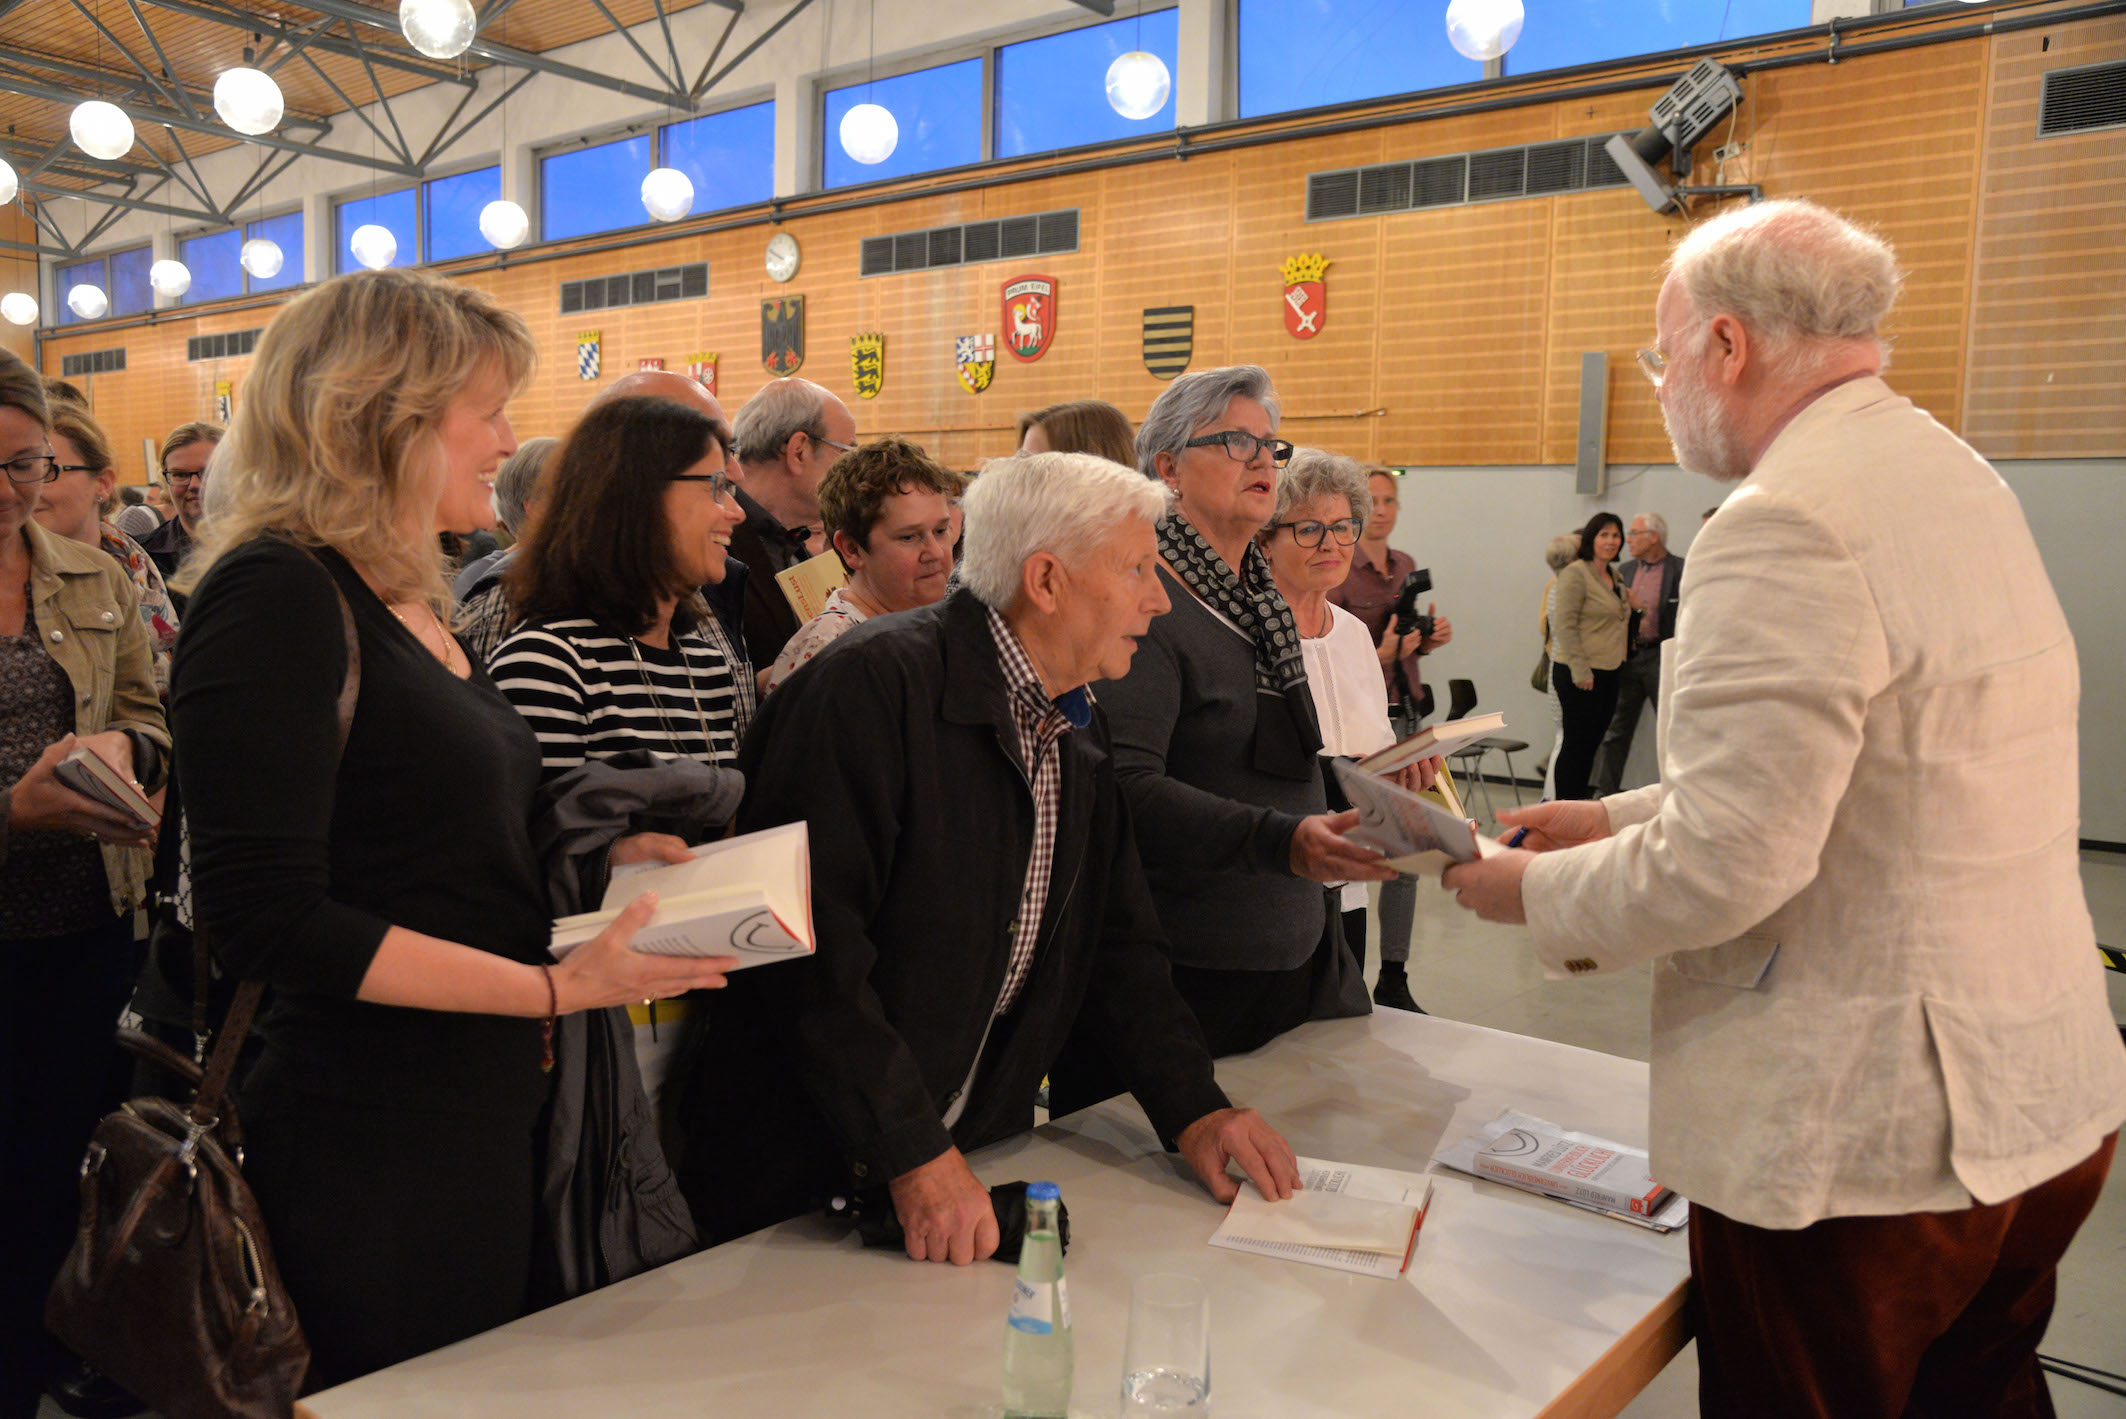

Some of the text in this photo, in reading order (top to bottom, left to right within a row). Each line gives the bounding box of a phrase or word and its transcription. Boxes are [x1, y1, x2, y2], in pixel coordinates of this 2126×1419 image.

[788, 575, 814, 619] enslust
[1566, 1147, 1617, 1179] GLÜCKLICH
[1575, 1186, 1590, 1196] LÜTZ
[1590, 1191, 1616, 1204] MANFRED
